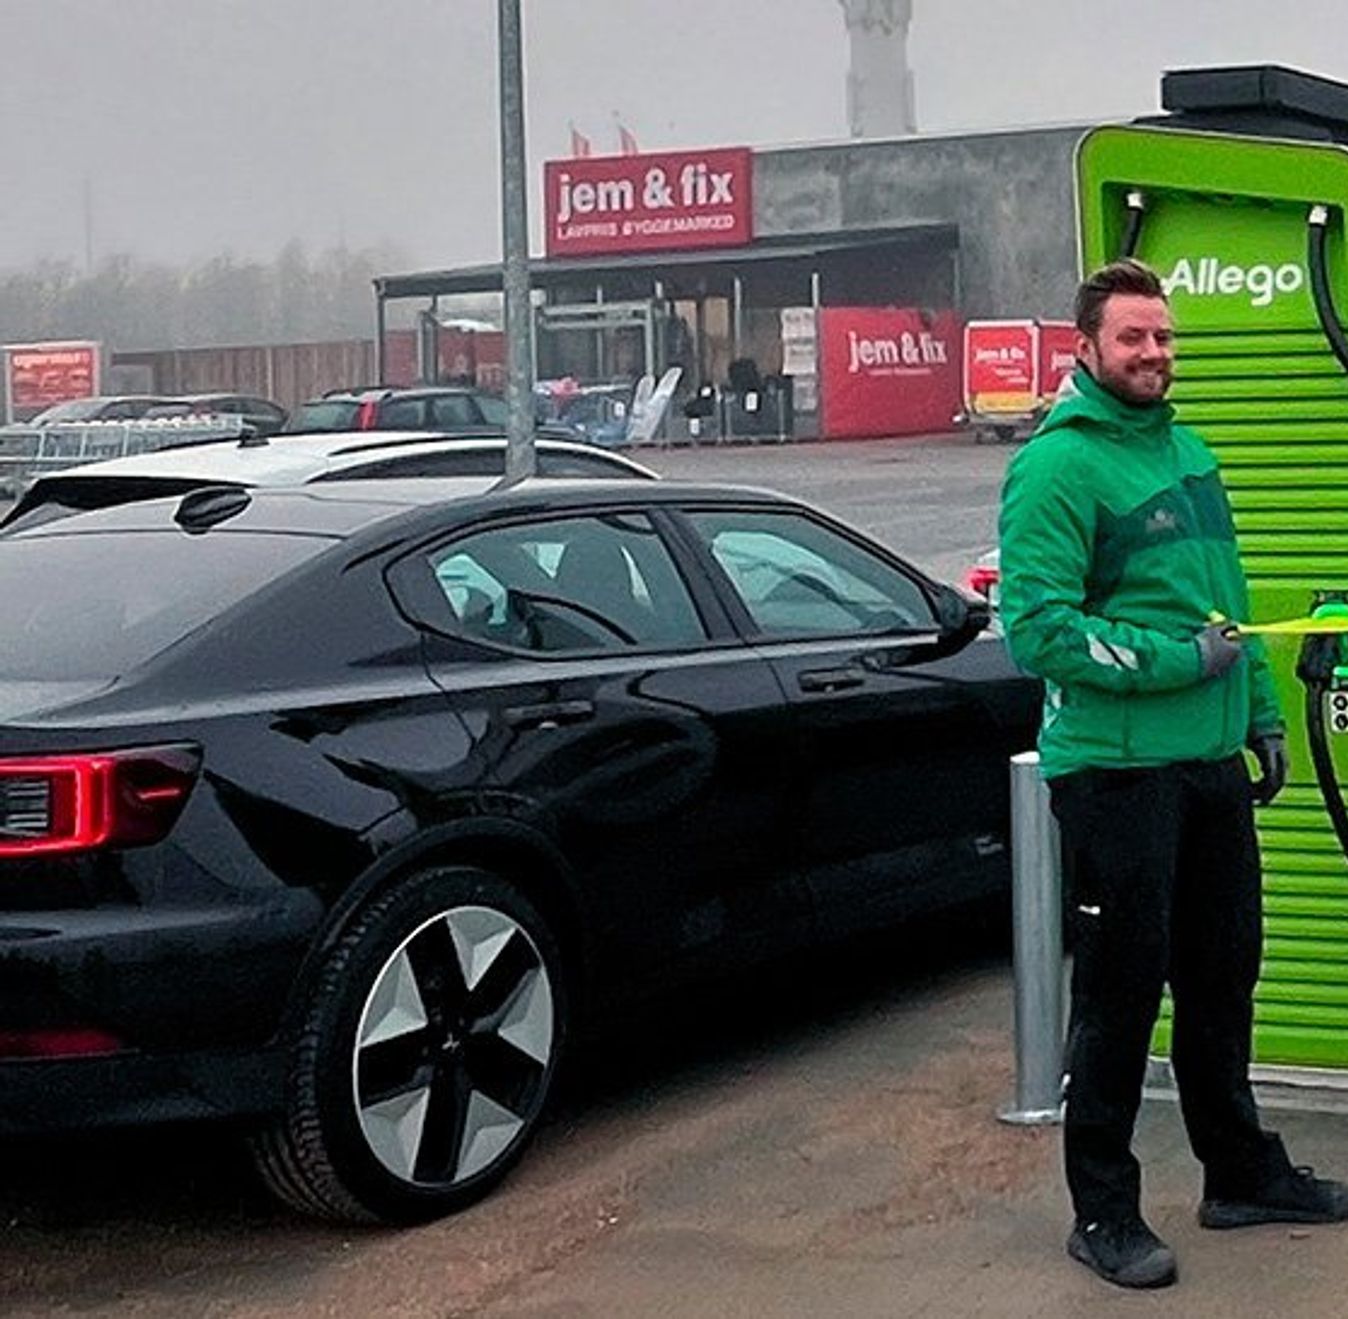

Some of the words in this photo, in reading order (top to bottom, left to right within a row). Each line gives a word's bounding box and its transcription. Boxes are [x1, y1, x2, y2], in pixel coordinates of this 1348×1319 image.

[557, 173, 634, 223] jem
[643, 168, 674, 209] &
[681, 163, 733, 206] fix
[1160, 257, 1304, 306] Allego
[848, 330, 899, 373] jem
[901, 331, 919, 364] &
[919, 331, 947, 364] fix
